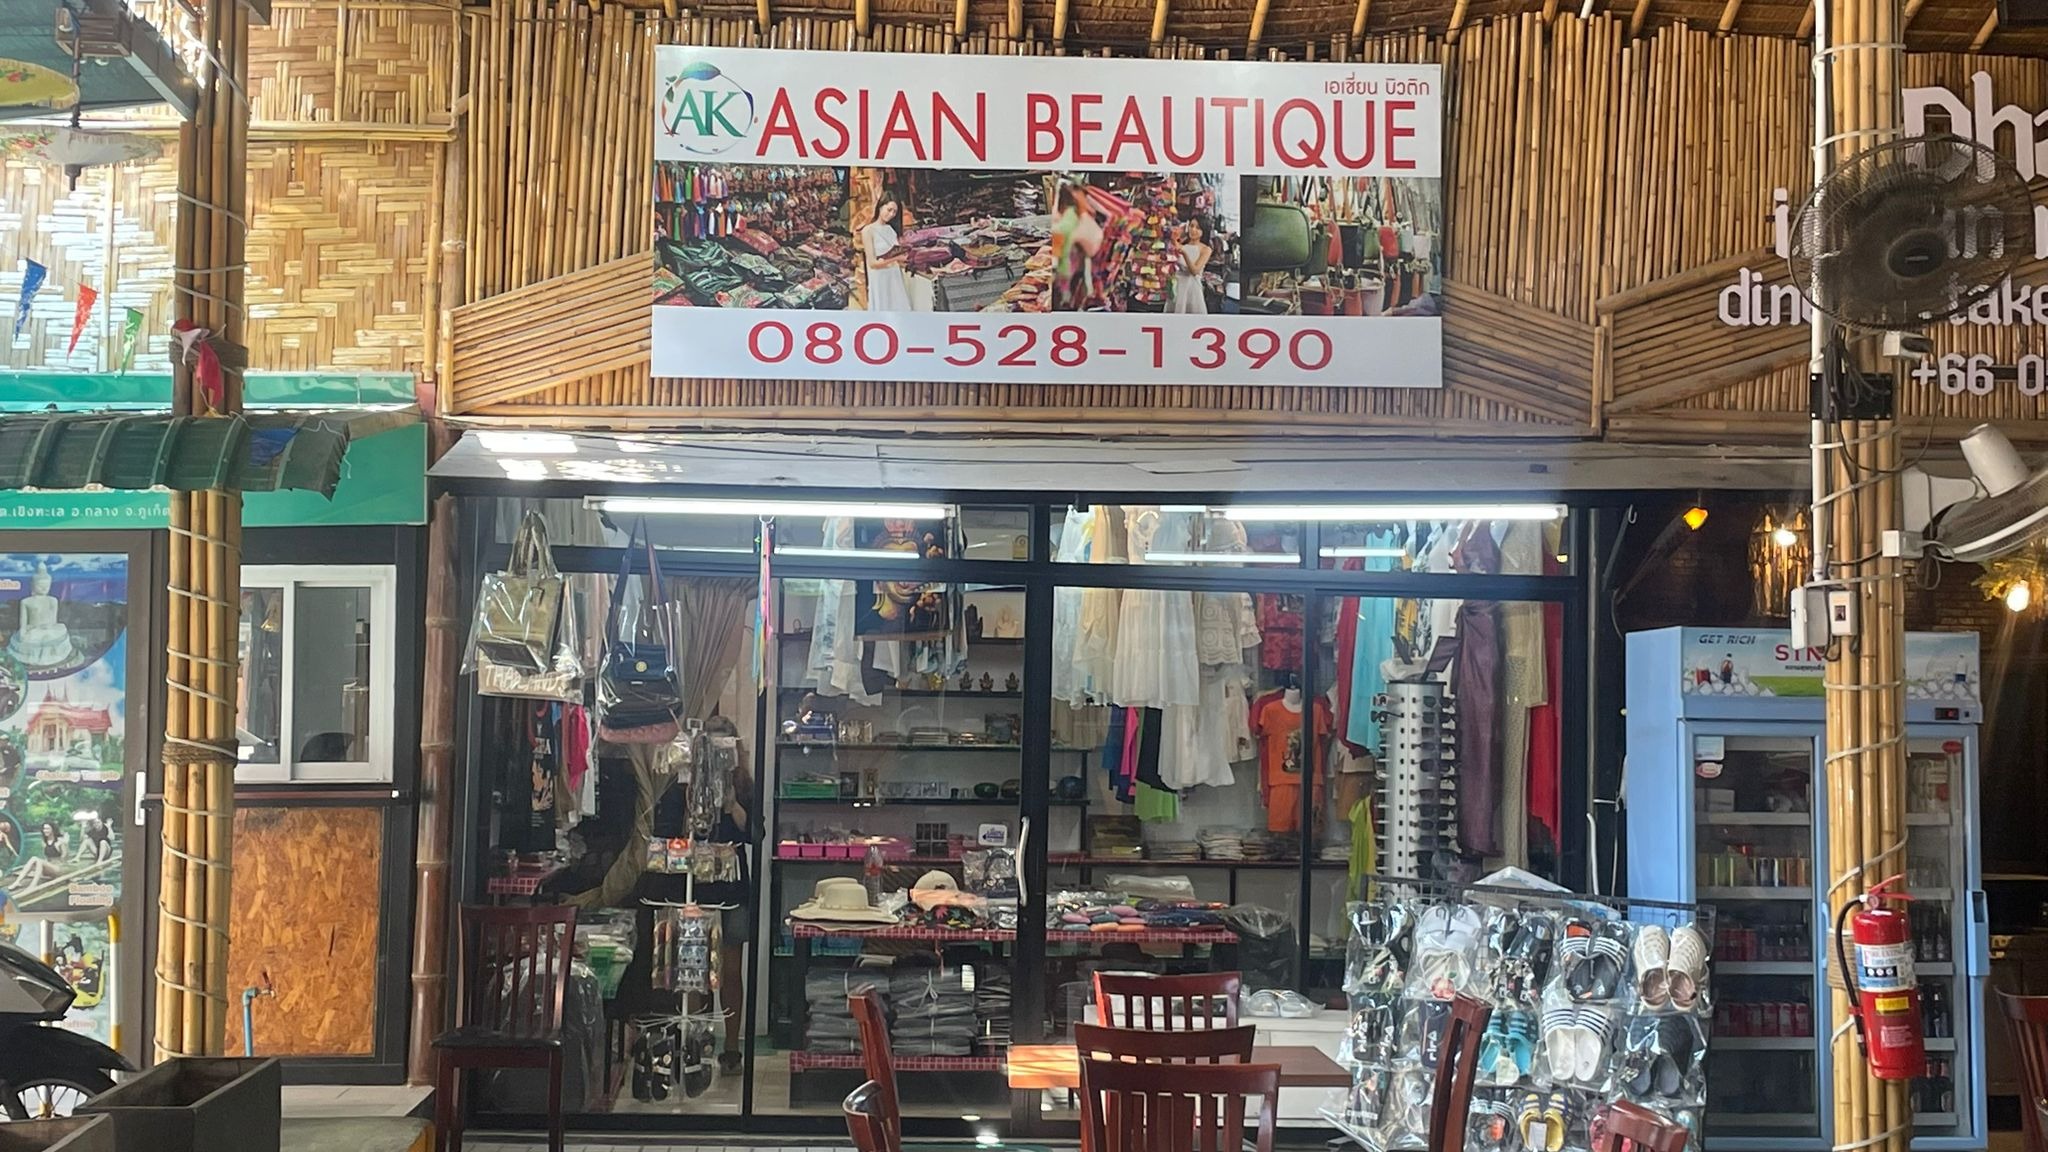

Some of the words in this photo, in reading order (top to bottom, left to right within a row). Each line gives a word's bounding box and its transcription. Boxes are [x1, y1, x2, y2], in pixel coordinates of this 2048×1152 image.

[1325, 72, 1378, 95] เอเชี่ยน
[1385, 78, 1430, 96] บิวติก
[668, 89, 747, 138] AK
[756, 87, 988, 161] ASIAN
[1027, 94, 1416, 169] BEAUTIQUE
[748, 320, 1333, 370] 080-528-1390
[1699, 634, 1723, 644] GET
[1727, 634, 1756, 645] RICH
